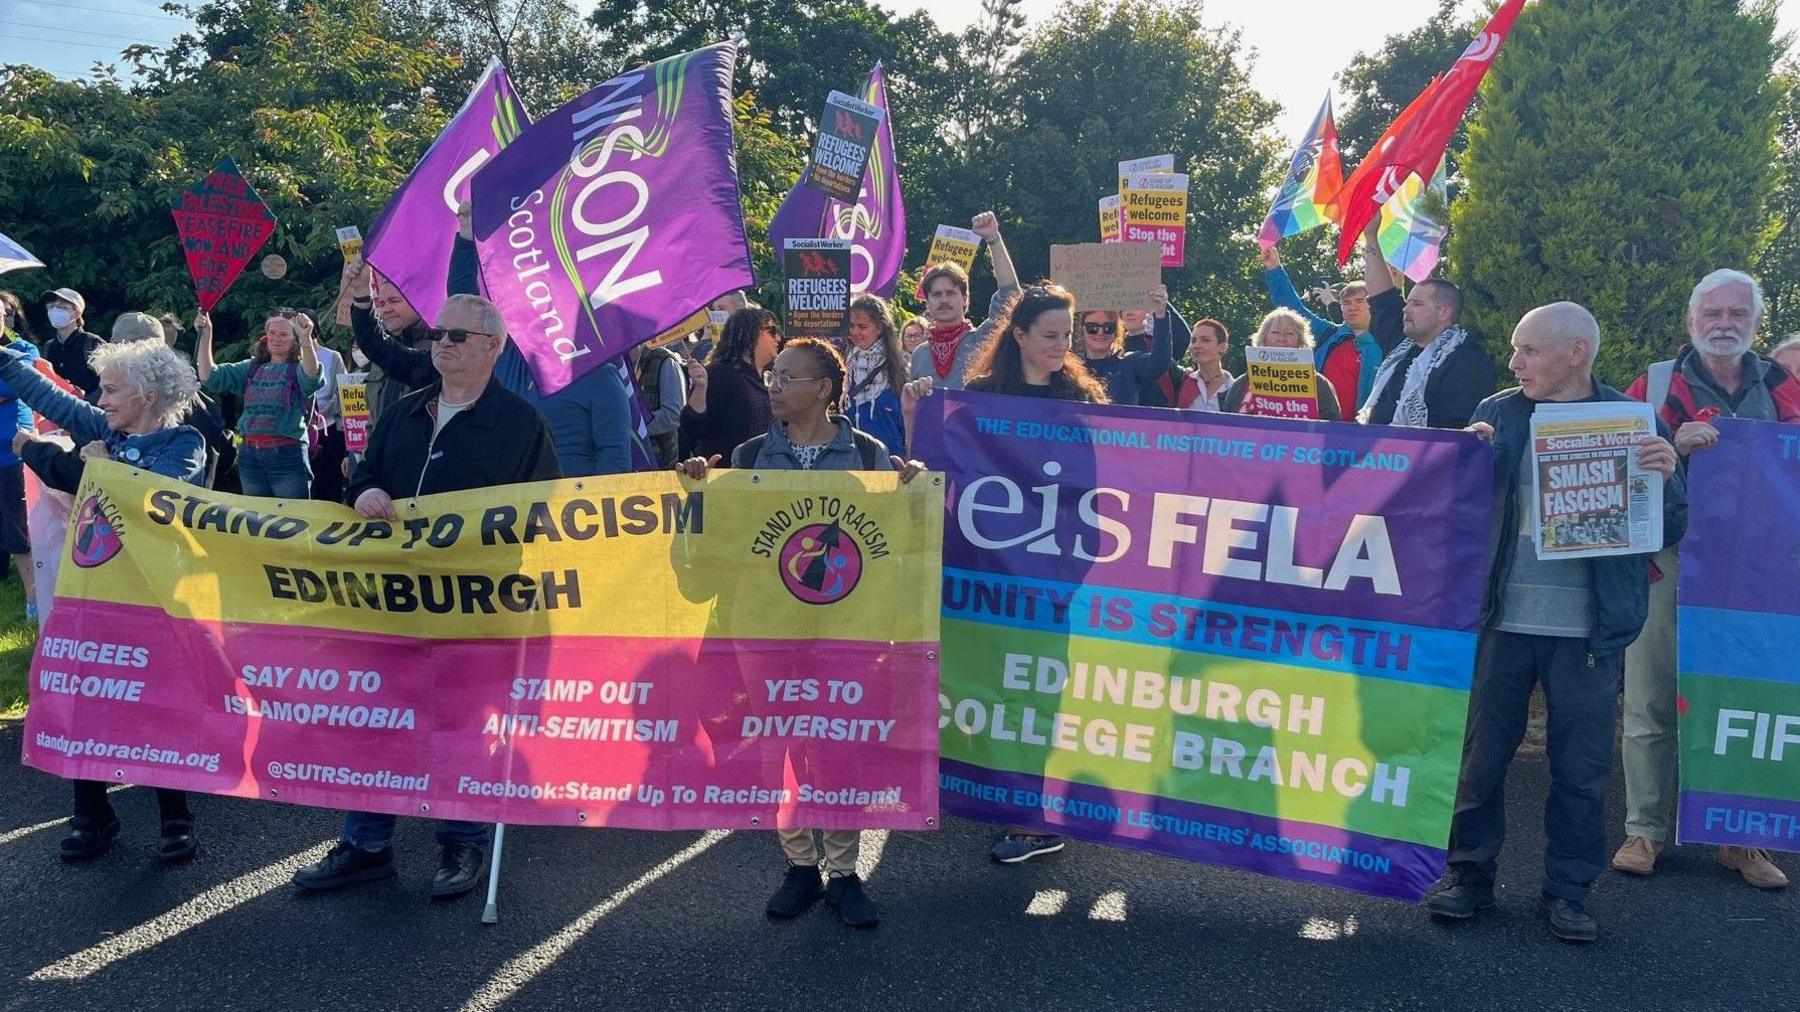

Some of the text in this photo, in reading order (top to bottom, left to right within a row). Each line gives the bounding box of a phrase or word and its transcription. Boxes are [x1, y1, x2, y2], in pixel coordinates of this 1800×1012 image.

[818, 131, 866, 163] REFUGEES
[815, 147, 862, 179] WELCOME
[571, 73, 663, 311] NISON
[1130, 193, 1183, 209] Refugees
[1129, 208, 1179, 221] welcome
[792, 240, 820, 248] Socialist
[934, 240, 974, 257] Refugees
[1129, 227, 1155, 242] Stop
[1157, 228, 1177, 241] the
[508, 189, 591, 365] Scotland
[788, 279, 847, 295] REFUGEES
[788, 294, 846, 311] WELCOME
[1251, 365, 1310, 381] Refugees
[1253, 381, 1308, 393] welcome
[343, 388, 365, 400] Refu
[344, 401, 367, 412] welc
[1255, 397, 1309, 413] Stop the
[975, 416, 1411, 473] THE EDUCATIONAL INSTITUTE OF SCOTLAND
[1547, 434, 1602, 450] Socialist
[1548, 459, 1616, 490] SMASH
[1543, 484, 1624, 516] FASCISM
[149, 489, 705, 549] STAND UP TO RACISM
[751, 496, 890, 560] STAND UP TO RACISM
[957, 460, 1402, 596] eis FELA
[262, 564, 582, 614] EDINBURGH
[943, 575, 1412, 671] UNITY IS STRENGTH
[41, 636, 150, 669] REFUGEES
[39, 669, 146, 702] WELCOME
[241, 664, 381, 694] SAY NO TO
[510, 678, 653, 705] STAMP OUT
[764, 678, 863, 704] YES TO
[1003, 653, 1325, 736] EDINBURGH
[224, 695, 416, 730] ISLAMOPHOBIA
[482, 712, 679, 743] ANTI-SEMITISM
[741, 715, 896, 743] DIVERSITY
[1714, 708, 1800, 762] FIF
[35, 731, 221, 772] standuptoracism.org
[267, 761, 430, 792] @SUTRScotland
[1172, 730, 1411, 807] BRANCH
[637, 783, 664, 807] Up
[671, 784, 697, 805] To
[703, 785, 791, 805] Racism
[797, 783, 901, 806] Scotland
[939, 773, 1008, 803] URTHER
[1013, 789, 1121, 824] EDUCATION
[1250, 832, 1390, 873] ASSOCIATION
